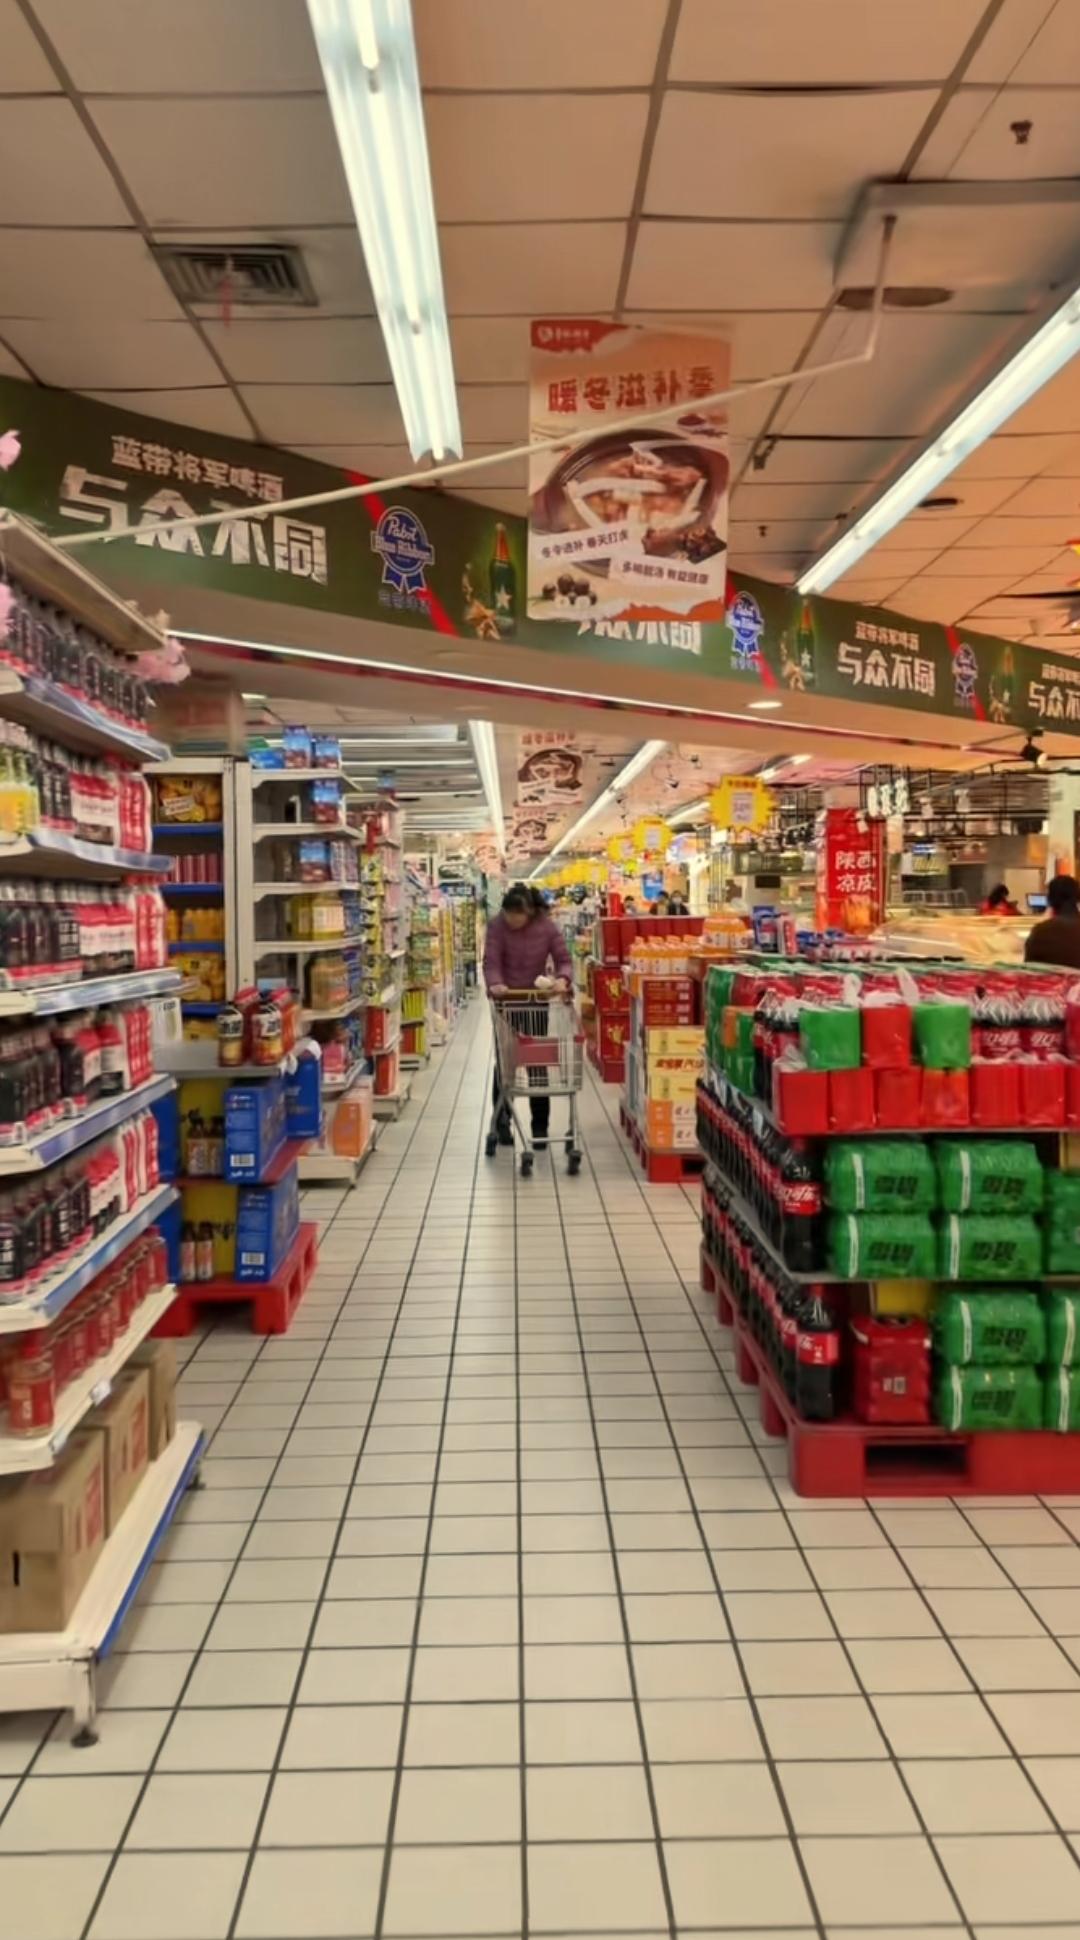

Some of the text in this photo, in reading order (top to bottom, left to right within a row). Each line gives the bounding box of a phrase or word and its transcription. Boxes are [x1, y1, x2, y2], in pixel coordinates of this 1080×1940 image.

[547, 366, 715, 414] 暖冬滋补季
[111, 435, 284, 502] 蓝带将军啤酒
[58, 464, 328, 586] 与众不同
[837, 640, 936, 697] 与众不同
